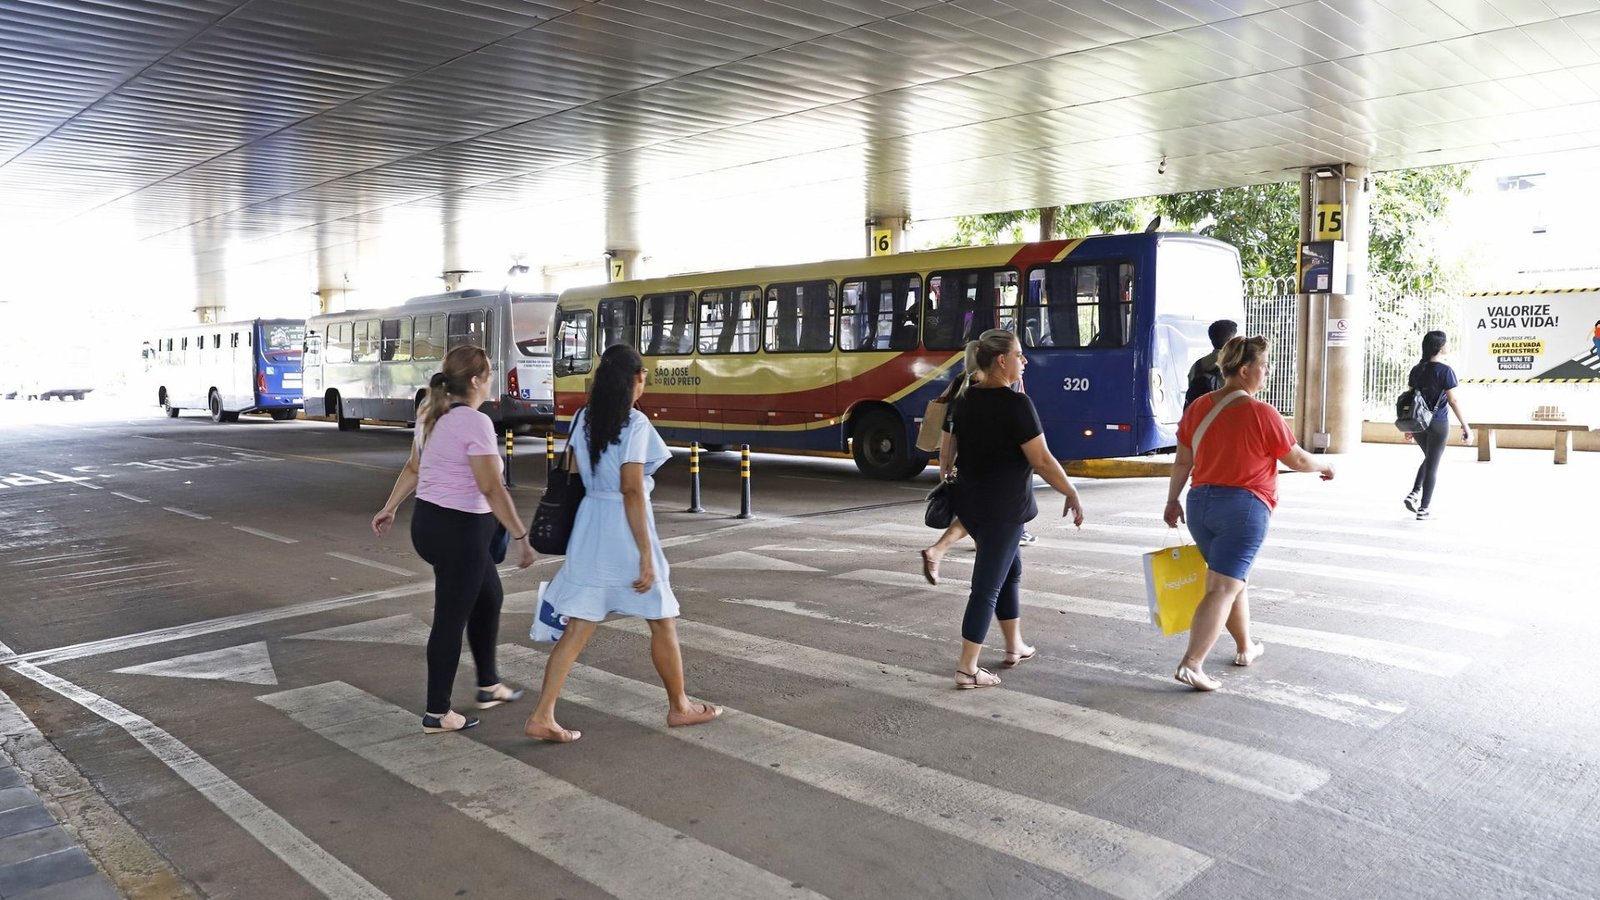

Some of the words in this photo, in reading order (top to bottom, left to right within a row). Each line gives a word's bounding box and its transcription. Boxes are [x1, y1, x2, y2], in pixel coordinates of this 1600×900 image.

[1317, 211, 1341, 233] 15
[873, 235, 889, 251] 16
[1487, 304, 1551, 317] VALORIZE
[1477, 318, 1487, 329] A
[1490, 317, 1517, 329] SUA
[1520, 316, 1559, 328] VIDA!
[654, 365, 669, 376] SÃO
[663, 376, 677, 386] RIO
[677, 376, 702, 386] PRETO
[1063, 377, 1090, 391] 320
